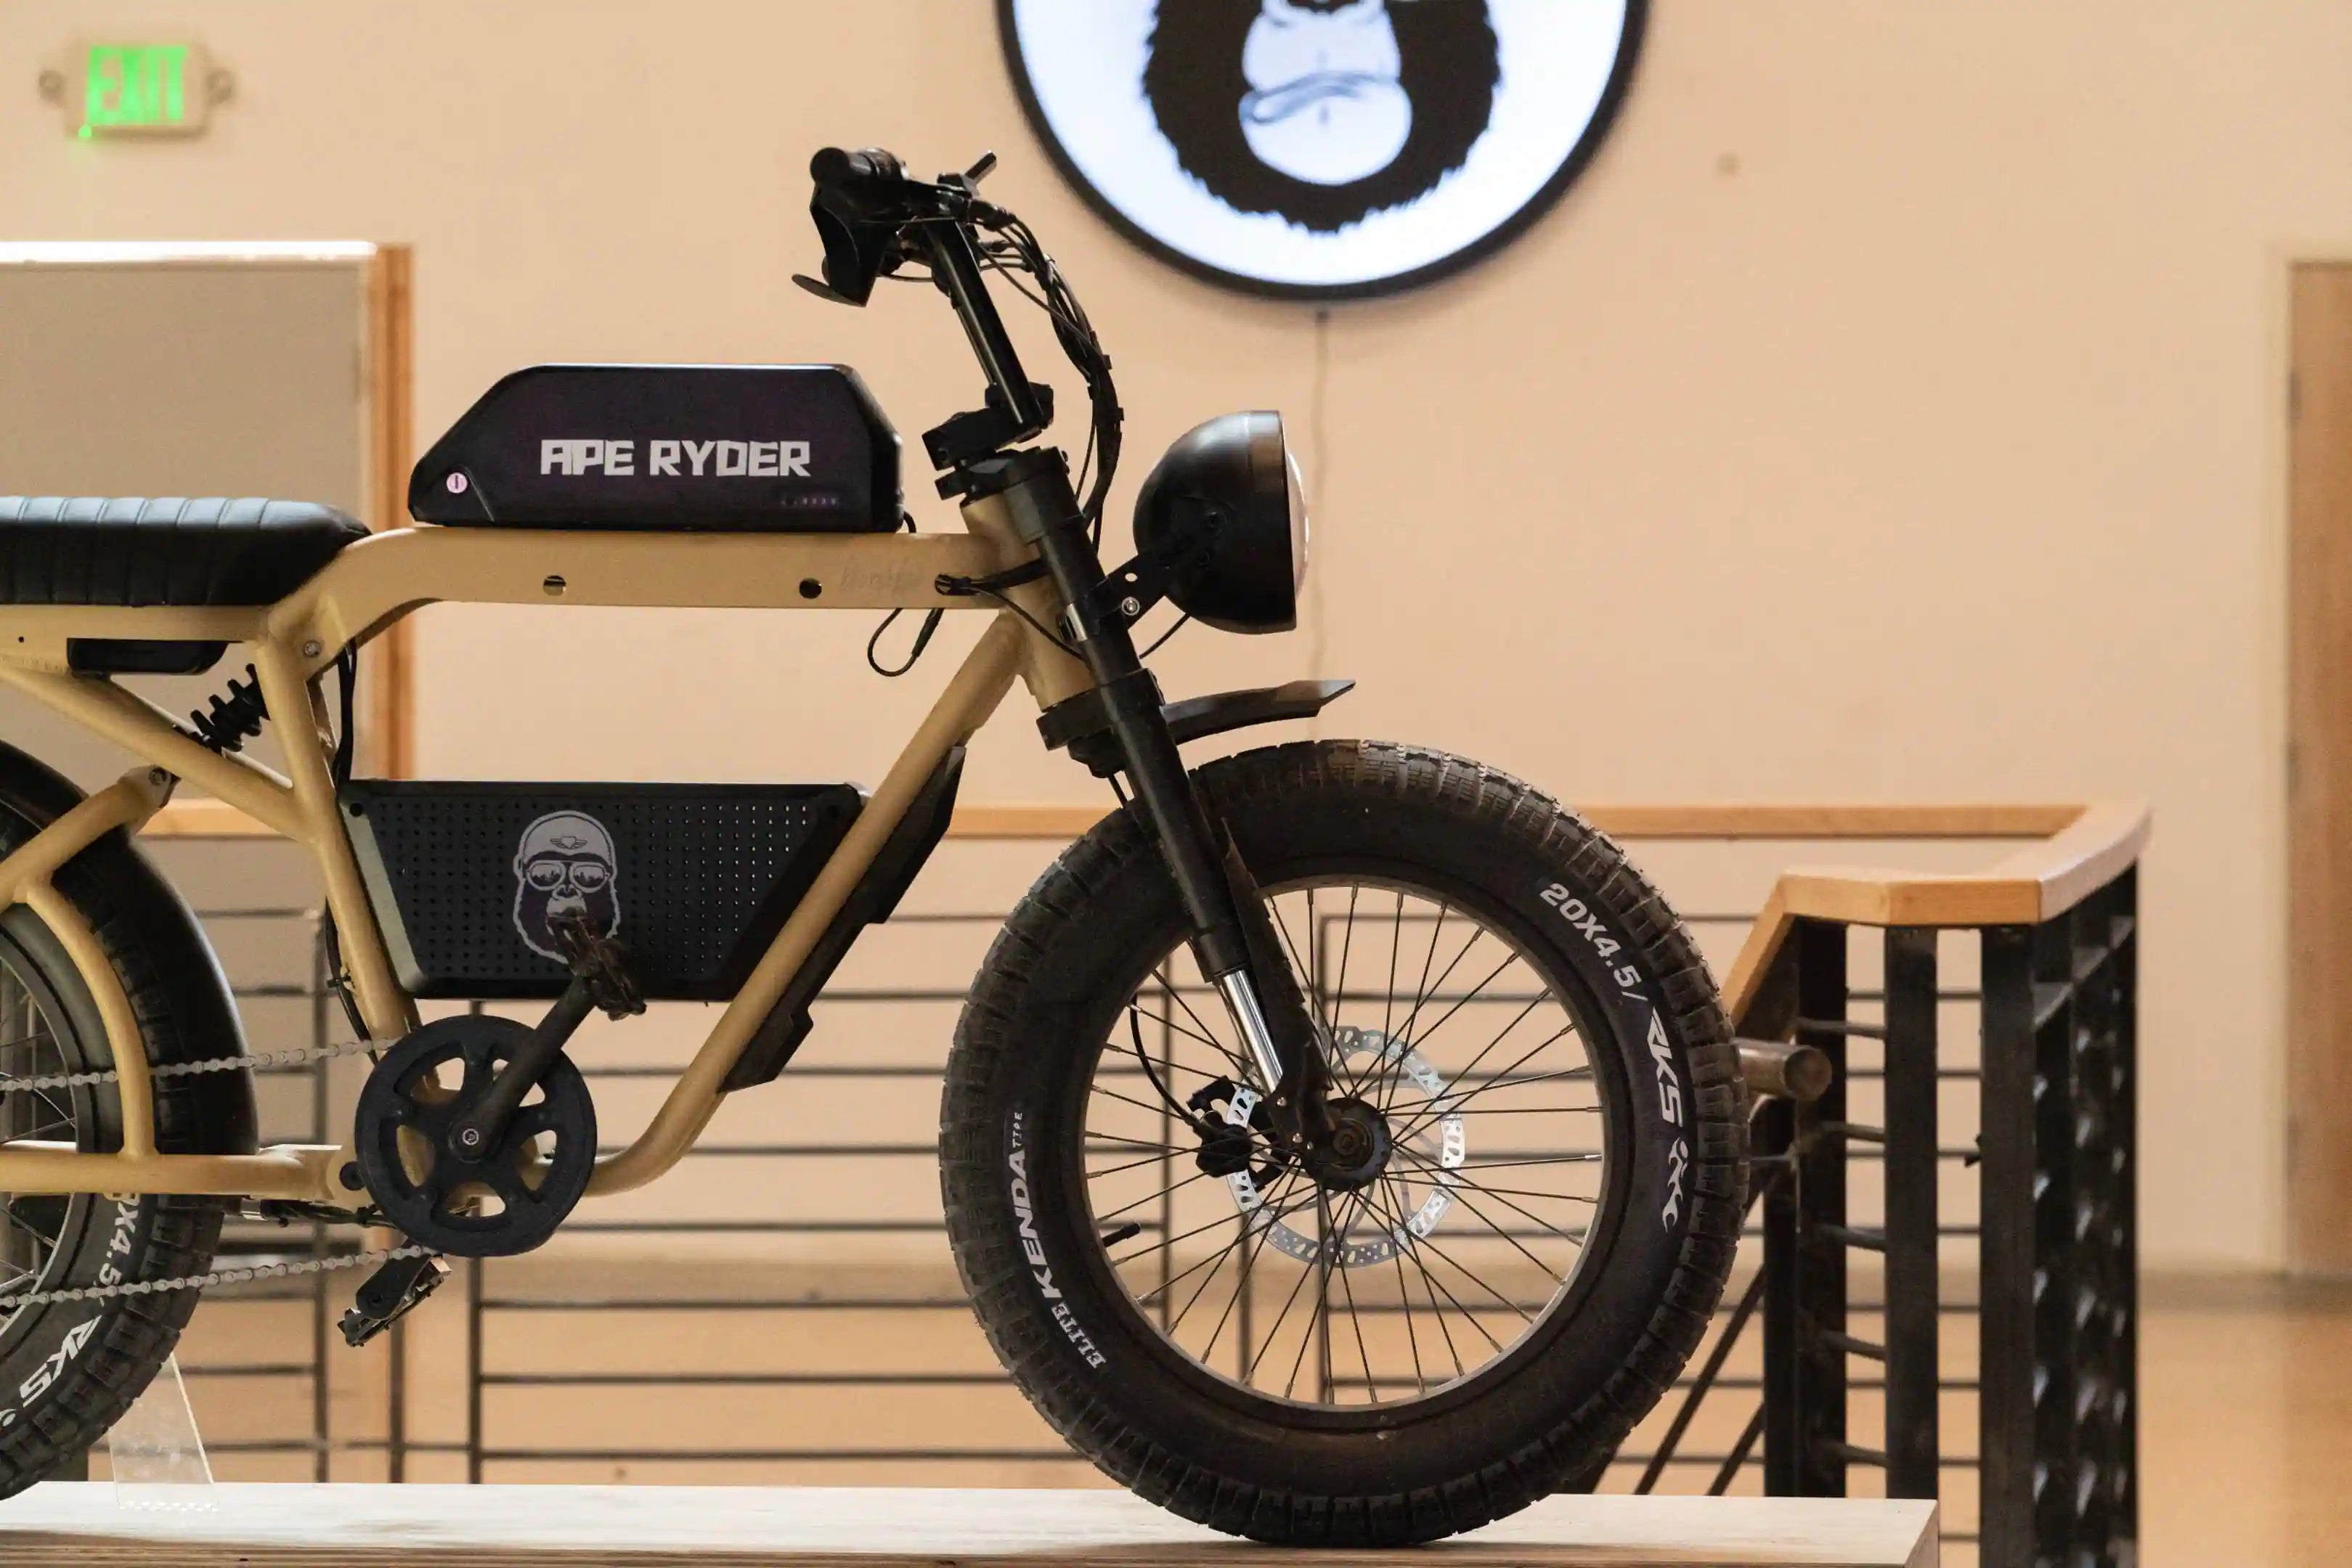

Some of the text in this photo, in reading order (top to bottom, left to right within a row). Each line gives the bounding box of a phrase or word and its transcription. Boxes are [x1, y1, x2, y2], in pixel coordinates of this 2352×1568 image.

[86, 45, 187, 125] EXIT
[540, 439, 811, 477] APE RYDER
[1009, 1149, 1062, 1299] KENDA
[1051, 1301, 1107, 1370] ELITE
